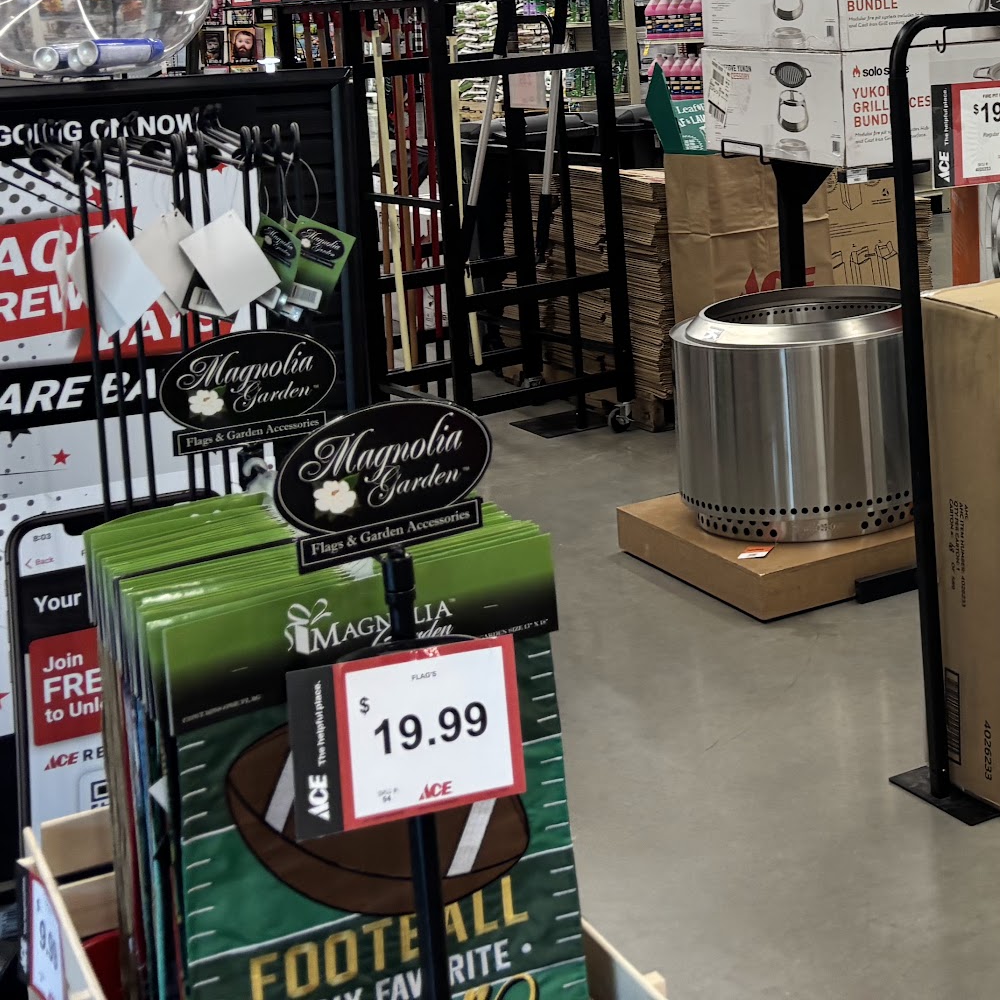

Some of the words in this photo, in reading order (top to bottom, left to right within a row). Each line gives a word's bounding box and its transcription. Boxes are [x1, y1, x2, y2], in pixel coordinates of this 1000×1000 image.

[862, 66, 883, 77] solo
[853, 100, 889, 114] GRILL
[854, 113, 891, 128] BUND
[137, 113, 200, 137] NOW
[938, 150, 951, 183] ACE
[176, 342, 315, 394] Magnolia
[232, 380, 310, 414] Garden
[185, 435, 214, 449] Flags
[227, 425, 263, 441] Garden
[265, 416, 320, 436] Accessories
[298, 412, 463, 483] Magnolia
[366, 464, 462, 508] Garden
[310, 539, 344, 557] Flags
[345, 535, 358, 546] &
[359, 525, 405, 544] Garden
[406, 508, 471, 534] Accessories
[33, 591, 82, 614] Your
[309, 600, 453, 653] MAGNLIA
[42, 652, 84, 673] Join
[411, 670, 437, 681] FLAG'S
[43, 667, 103, 704] FRE
[313, 680, 325, 711] place.
[44, 708, 65, 723] to
[315, 711, 327, 750] helpful
[359, 696, 370, 715] $
[374, 700, 488, 755] 19.99
[44, 751, 80, 772] ACE
[317, 751, 328, 767] The
[983, 719, 993, 781] 4026233
[307, 774, 331, 822] ACE
[418, 780, 453, 802] ACE
[375, 938, 513, 1000] FAVRITE
